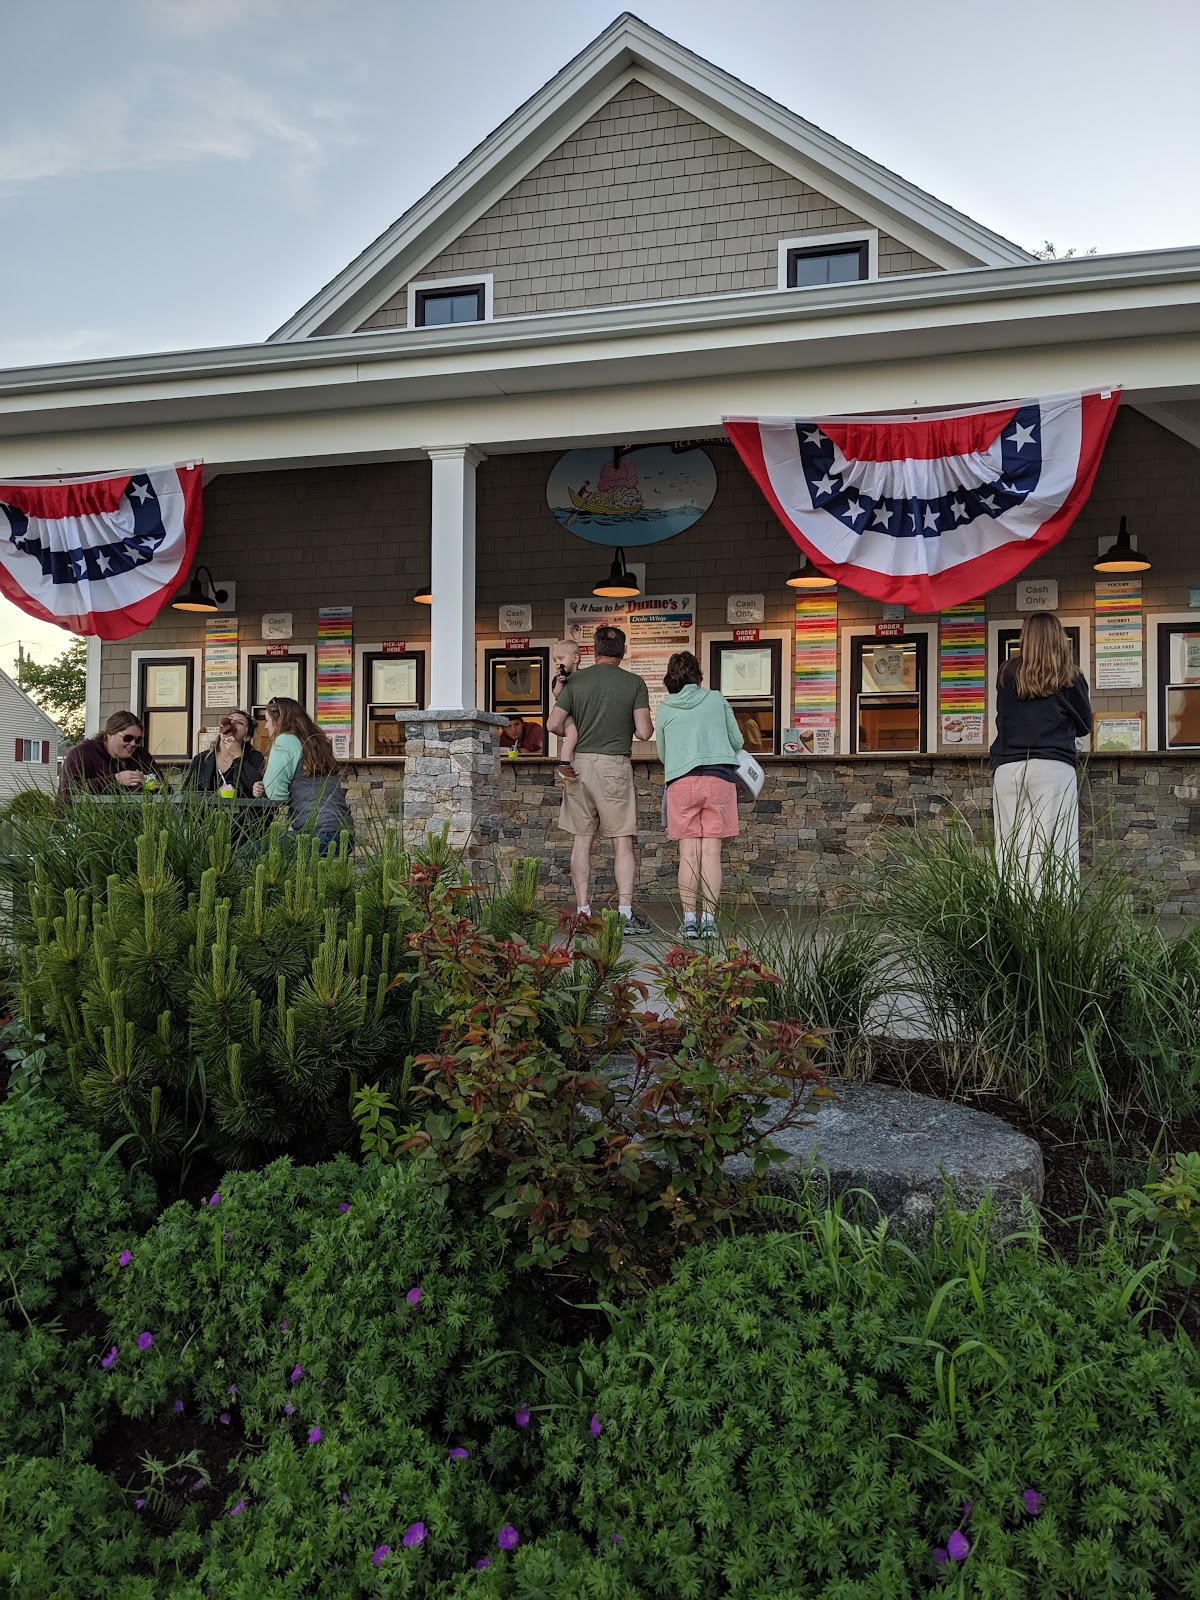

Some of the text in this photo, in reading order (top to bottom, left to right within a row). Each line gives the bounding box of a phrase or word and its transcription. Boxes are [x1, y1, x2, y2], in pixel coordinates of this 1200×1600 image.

[1025, 586, 1049, 594] Cash
[735, 599, 756, 608] Cash
[1025, 596, 1047, 606] Only
[579, 598, 678, 614] It has to be Dunne's
[649, 615, 667, 623] Whip
[735, 610, 754, 619] Only
[506, 619, 523, 627] Only
